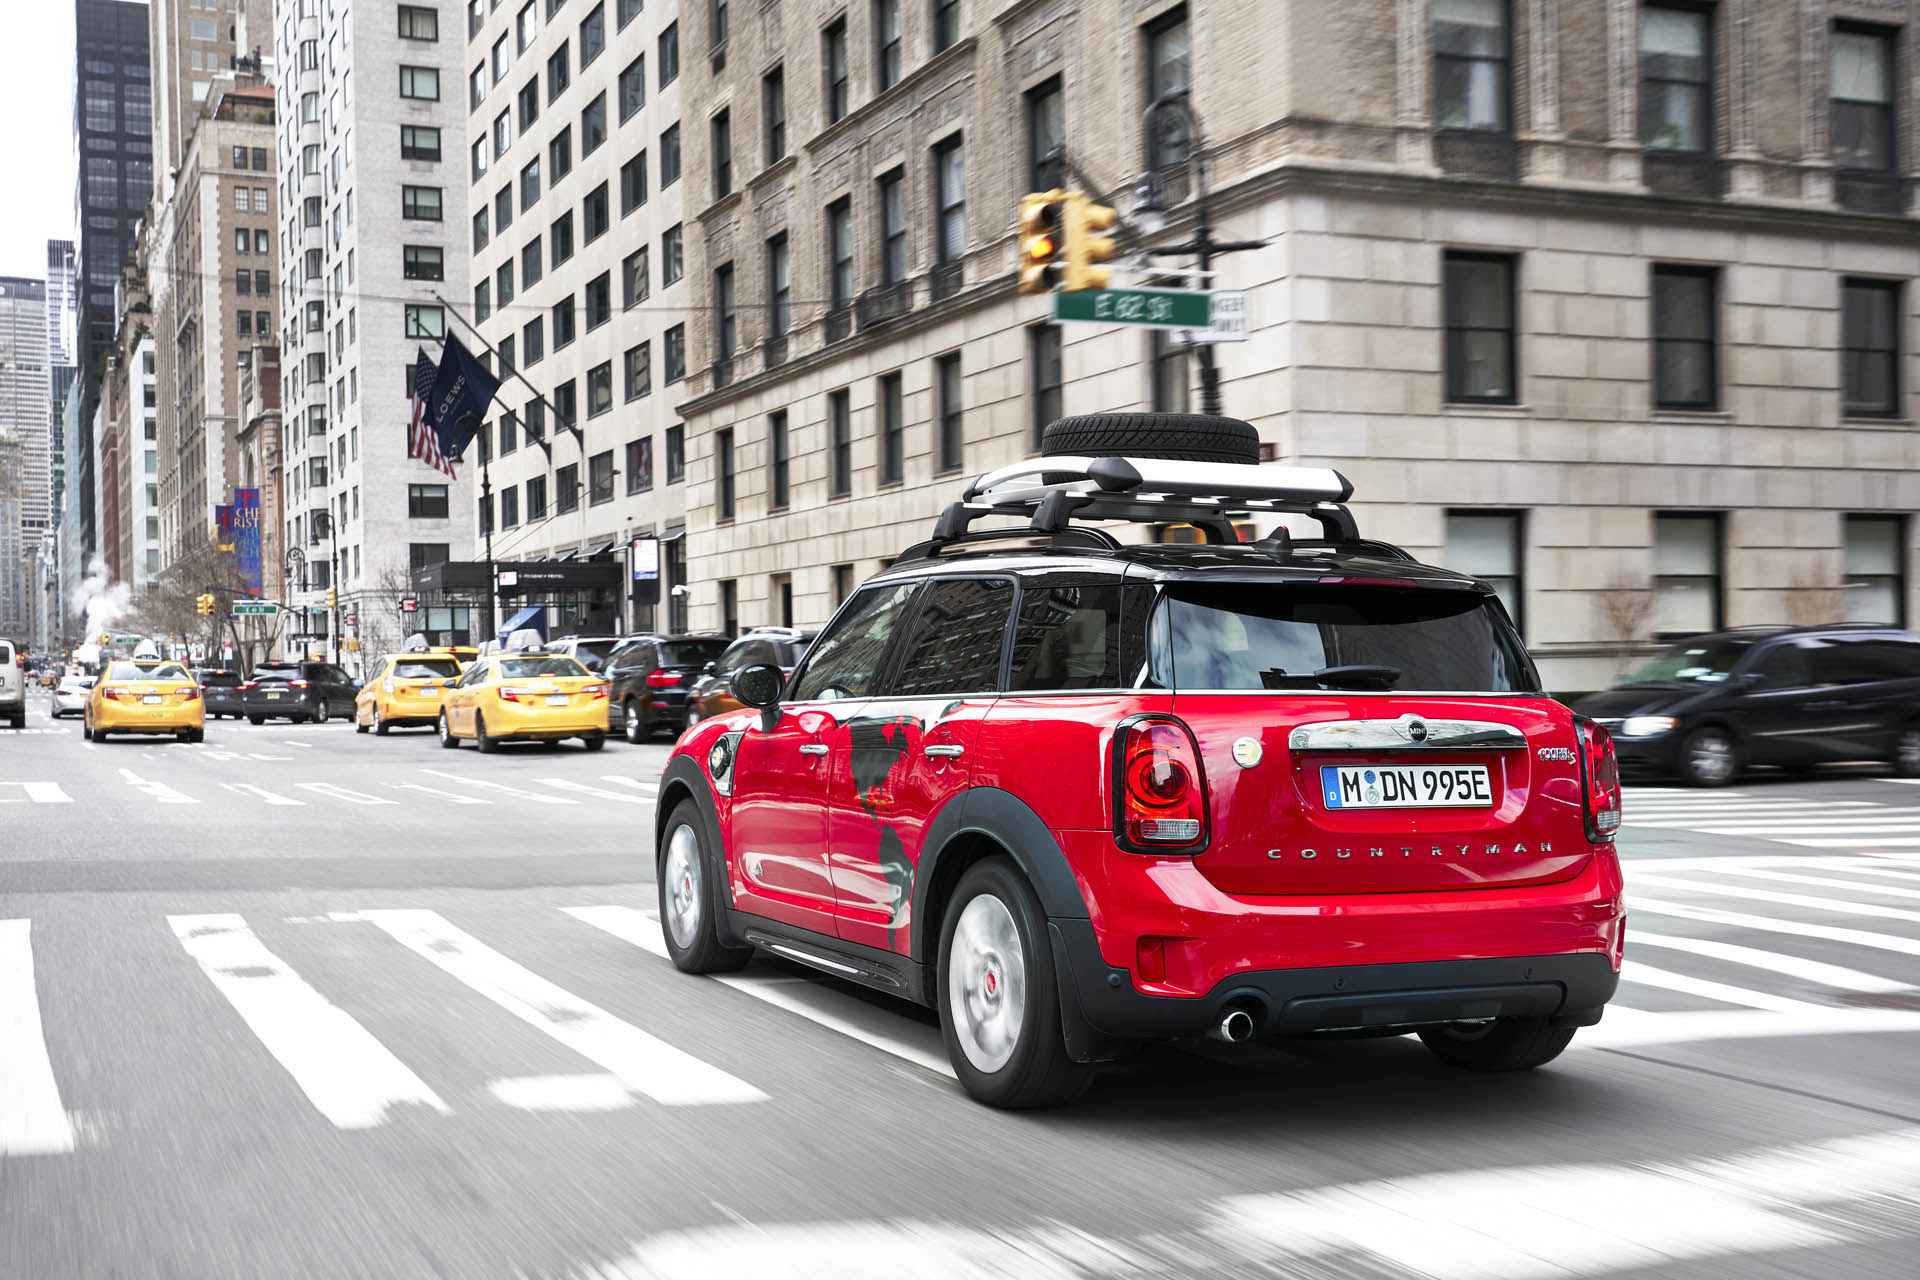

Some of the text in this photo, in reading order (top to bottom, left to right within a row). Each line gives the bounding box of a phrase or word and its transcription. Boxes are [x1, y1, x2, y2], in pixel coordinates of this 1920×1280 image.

[1096, 293, 1113, 317] E
[436, 375, 465, 423] LOEWS
[1329, 770, 1490, 802] D M DN 995E
[1268, 842, 1552, 860] COUNTRYMAN
